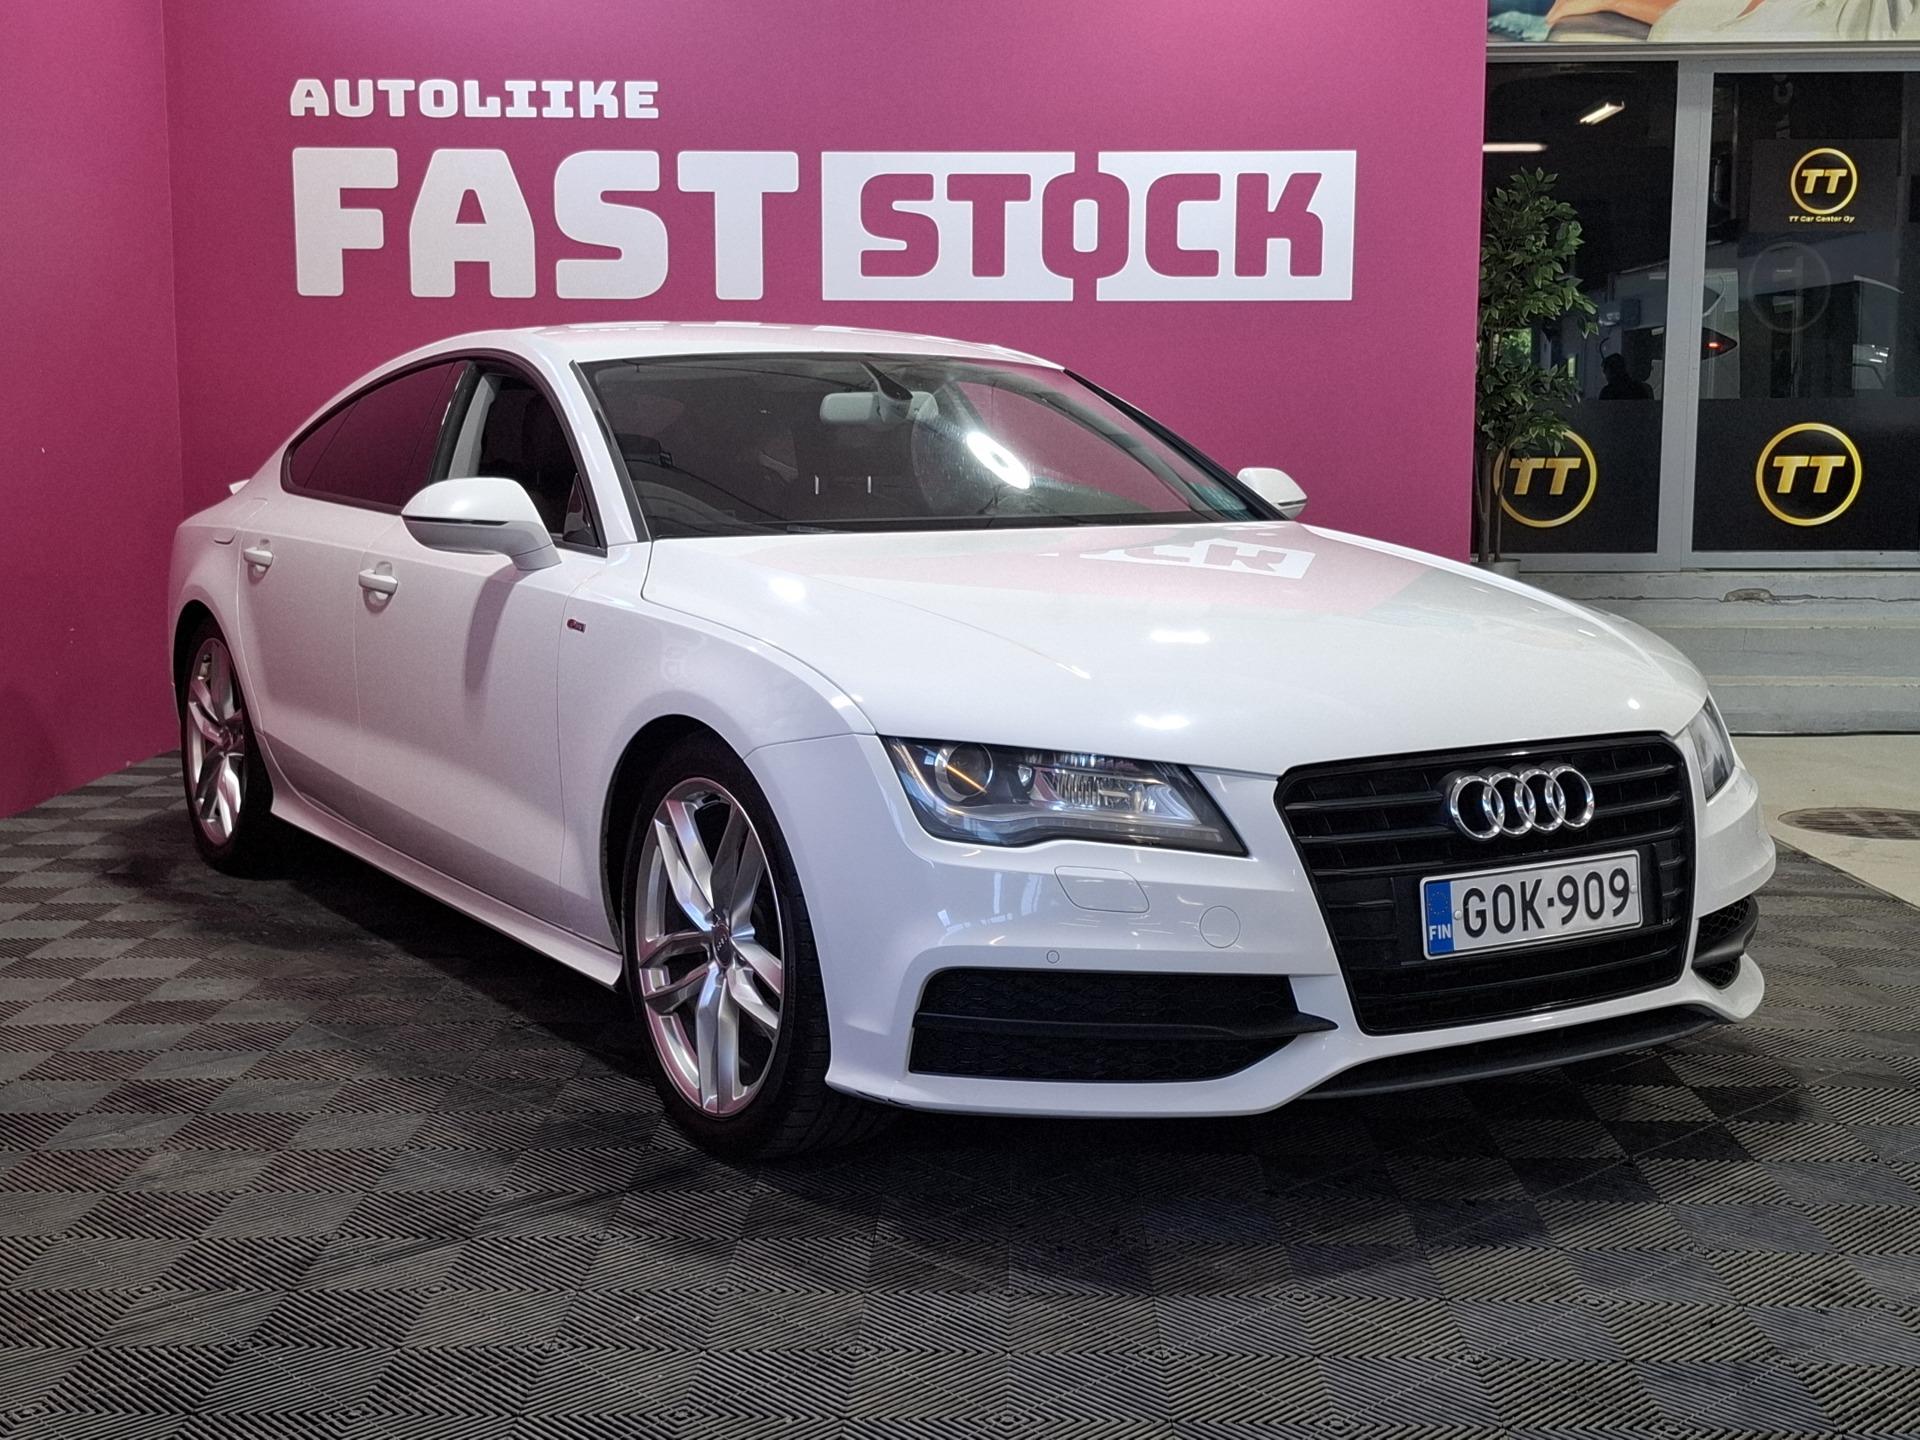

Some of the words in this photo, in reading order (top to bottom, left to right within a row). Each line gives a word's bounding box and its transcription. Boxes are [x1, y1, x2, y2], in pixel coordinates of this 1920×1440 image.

[289, 78, 659, 119] AUTOLIIKE
[1801, 169, 1848, 194] TT
[292, 147, 800, 300] FAST
[858, 171, 1325, 279] STOCK
[1800, 215, 1815, 223] Car
[1509, 456, 1582, 496] TT
[1772, 454, 1847, 494] TT
[1428, 923, 1452, 942] FIN
